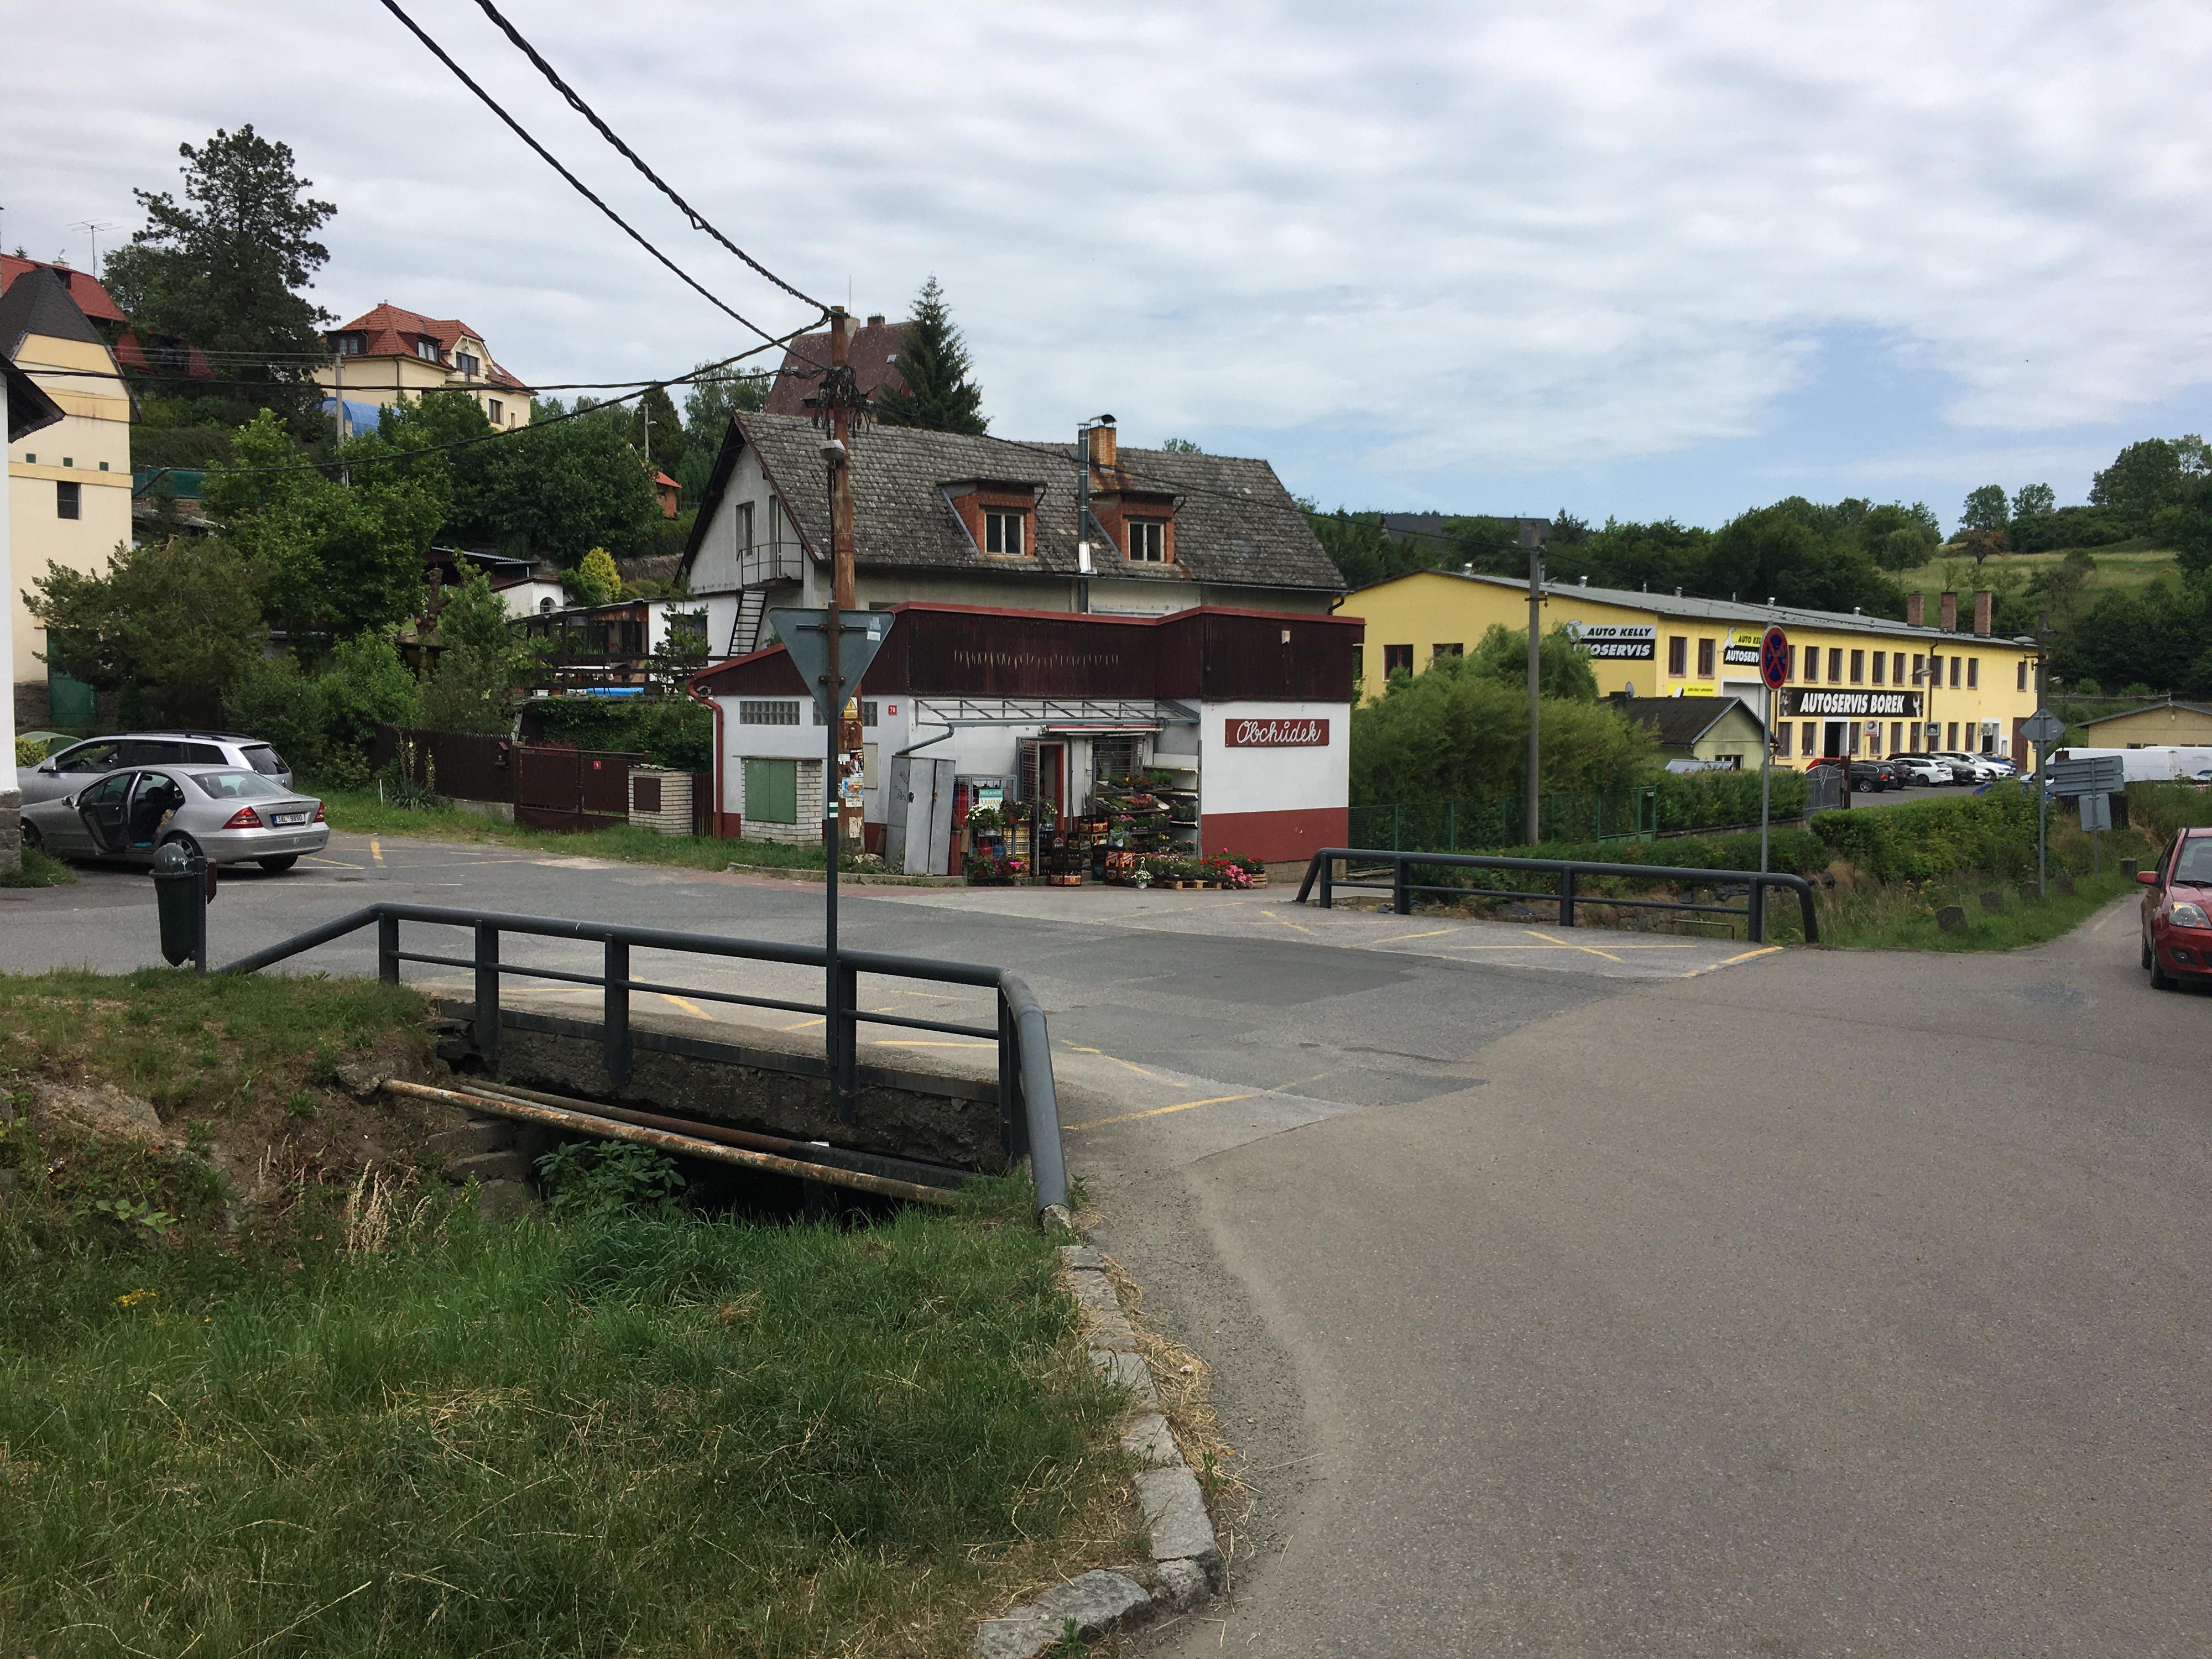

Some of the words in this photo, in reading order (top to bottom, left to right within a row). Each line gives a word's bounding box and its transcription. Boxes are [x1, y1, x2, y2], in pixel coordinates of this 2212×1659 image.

[1573, 644, 1651, 656] OSERVIS
[1725, 650, 1760, 663] AUTOSERV
[1799, 692, 1868, 714] AUTOSERVIS
[1870, 695, 1905, 713] BOREK
[1237, 721, 1322, 744] Obchůdek
